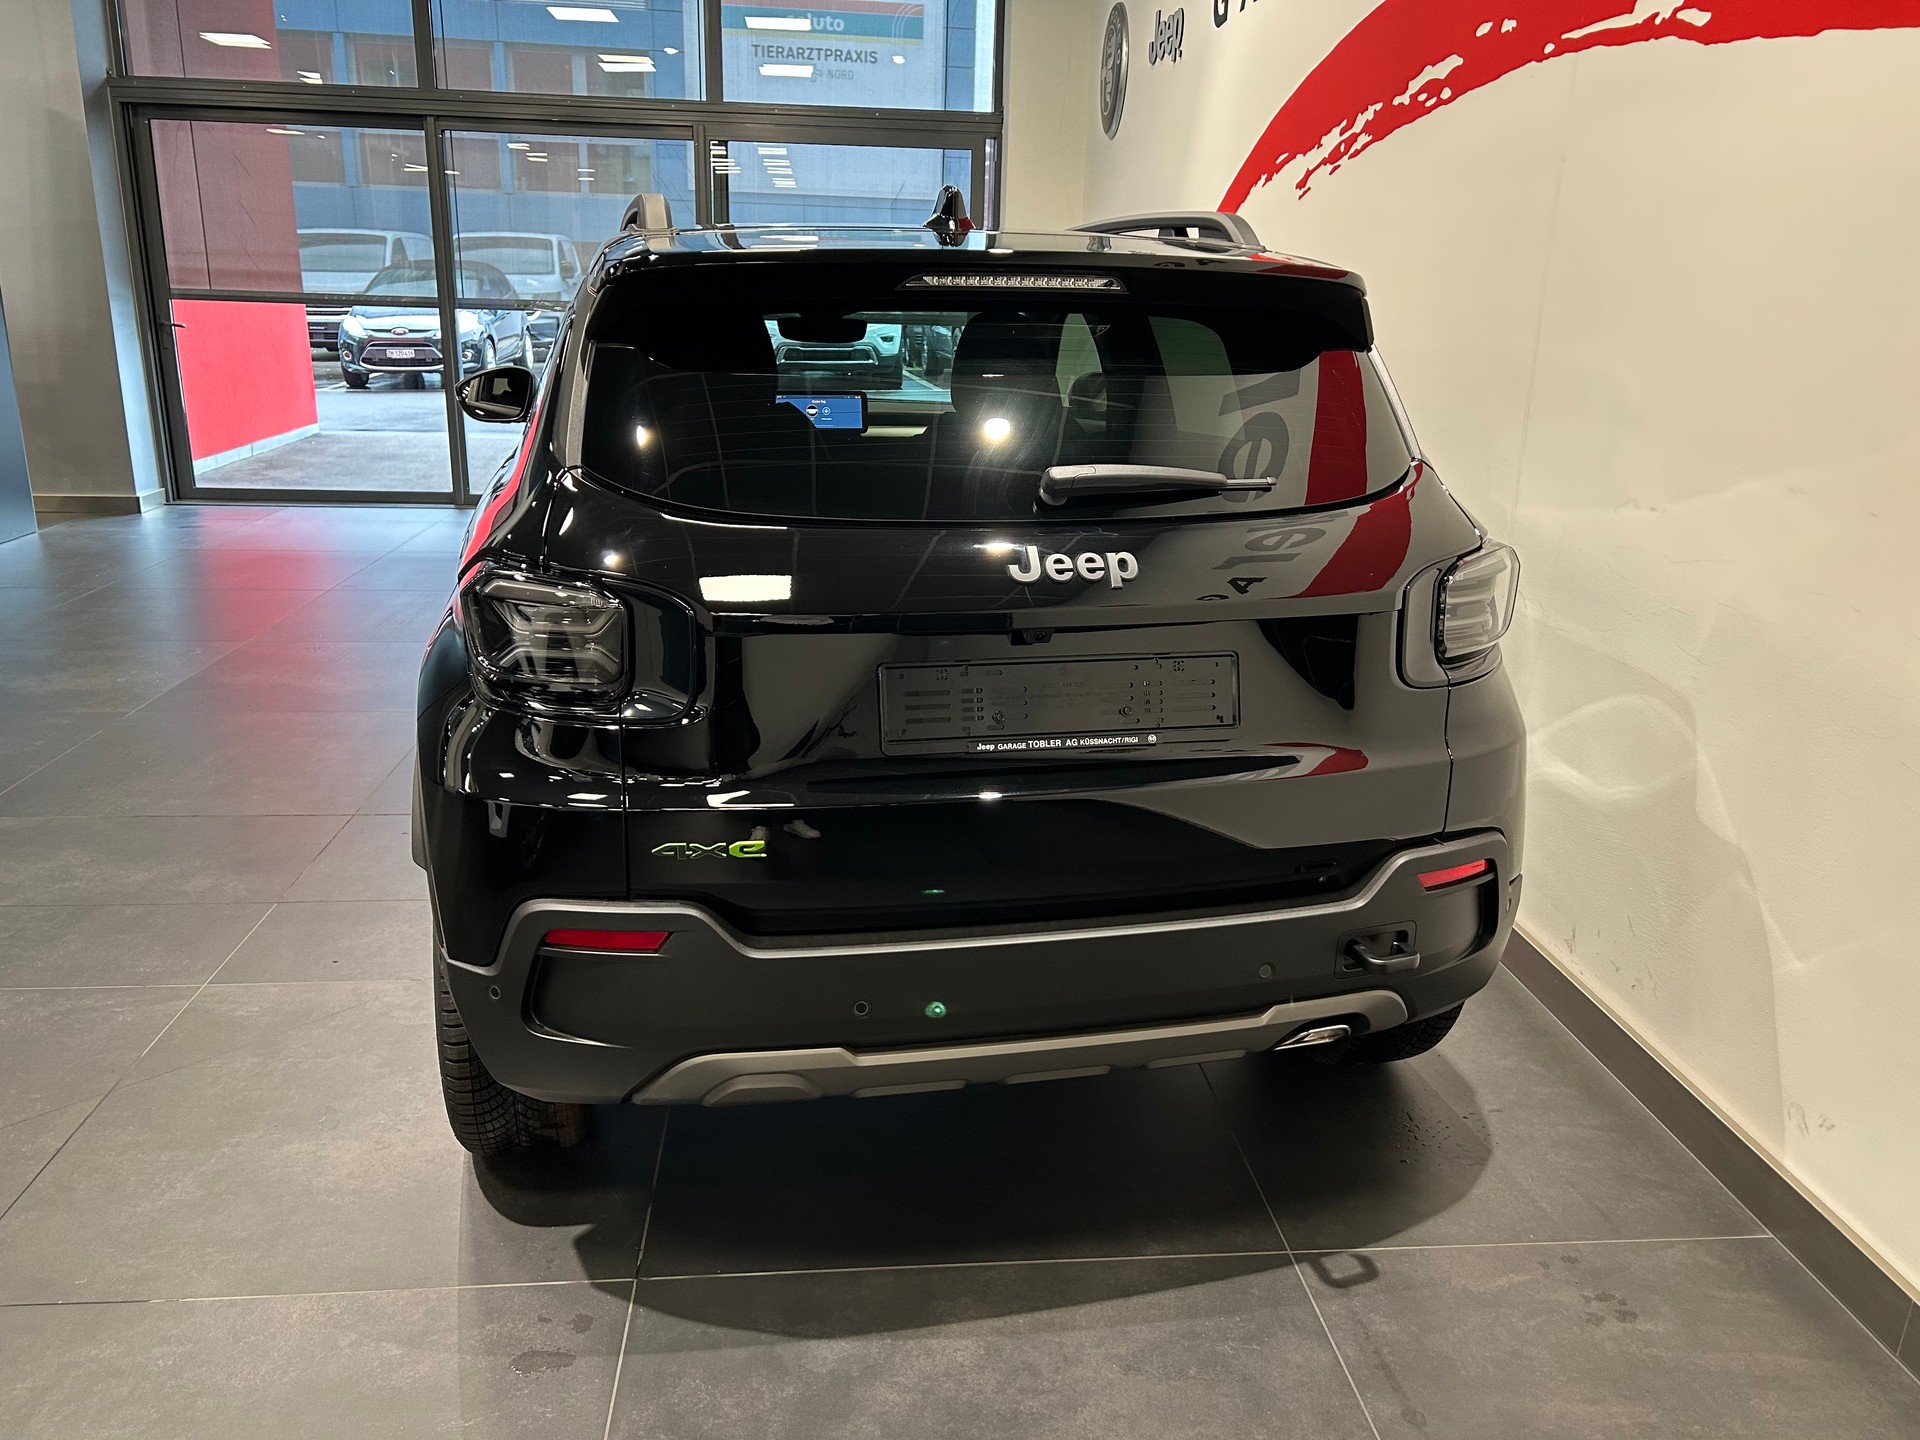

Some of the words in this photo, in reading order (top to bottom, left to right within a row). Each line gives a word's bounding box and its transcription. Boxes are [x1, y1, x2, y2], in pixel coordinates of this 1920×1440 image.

[1149, 8, 1184, 65] Jeep
[752, 44, 878, 64] TIERARZTPRAXIS
[1008, 545, 1139, 589] Jeep
[976, 742, 995, 751] Jeep
[997, 742, 1027, 750] GARAGE
[1028, 739, 1062, 748] TOBLER
[1065, 738, 1078, 747] AG
